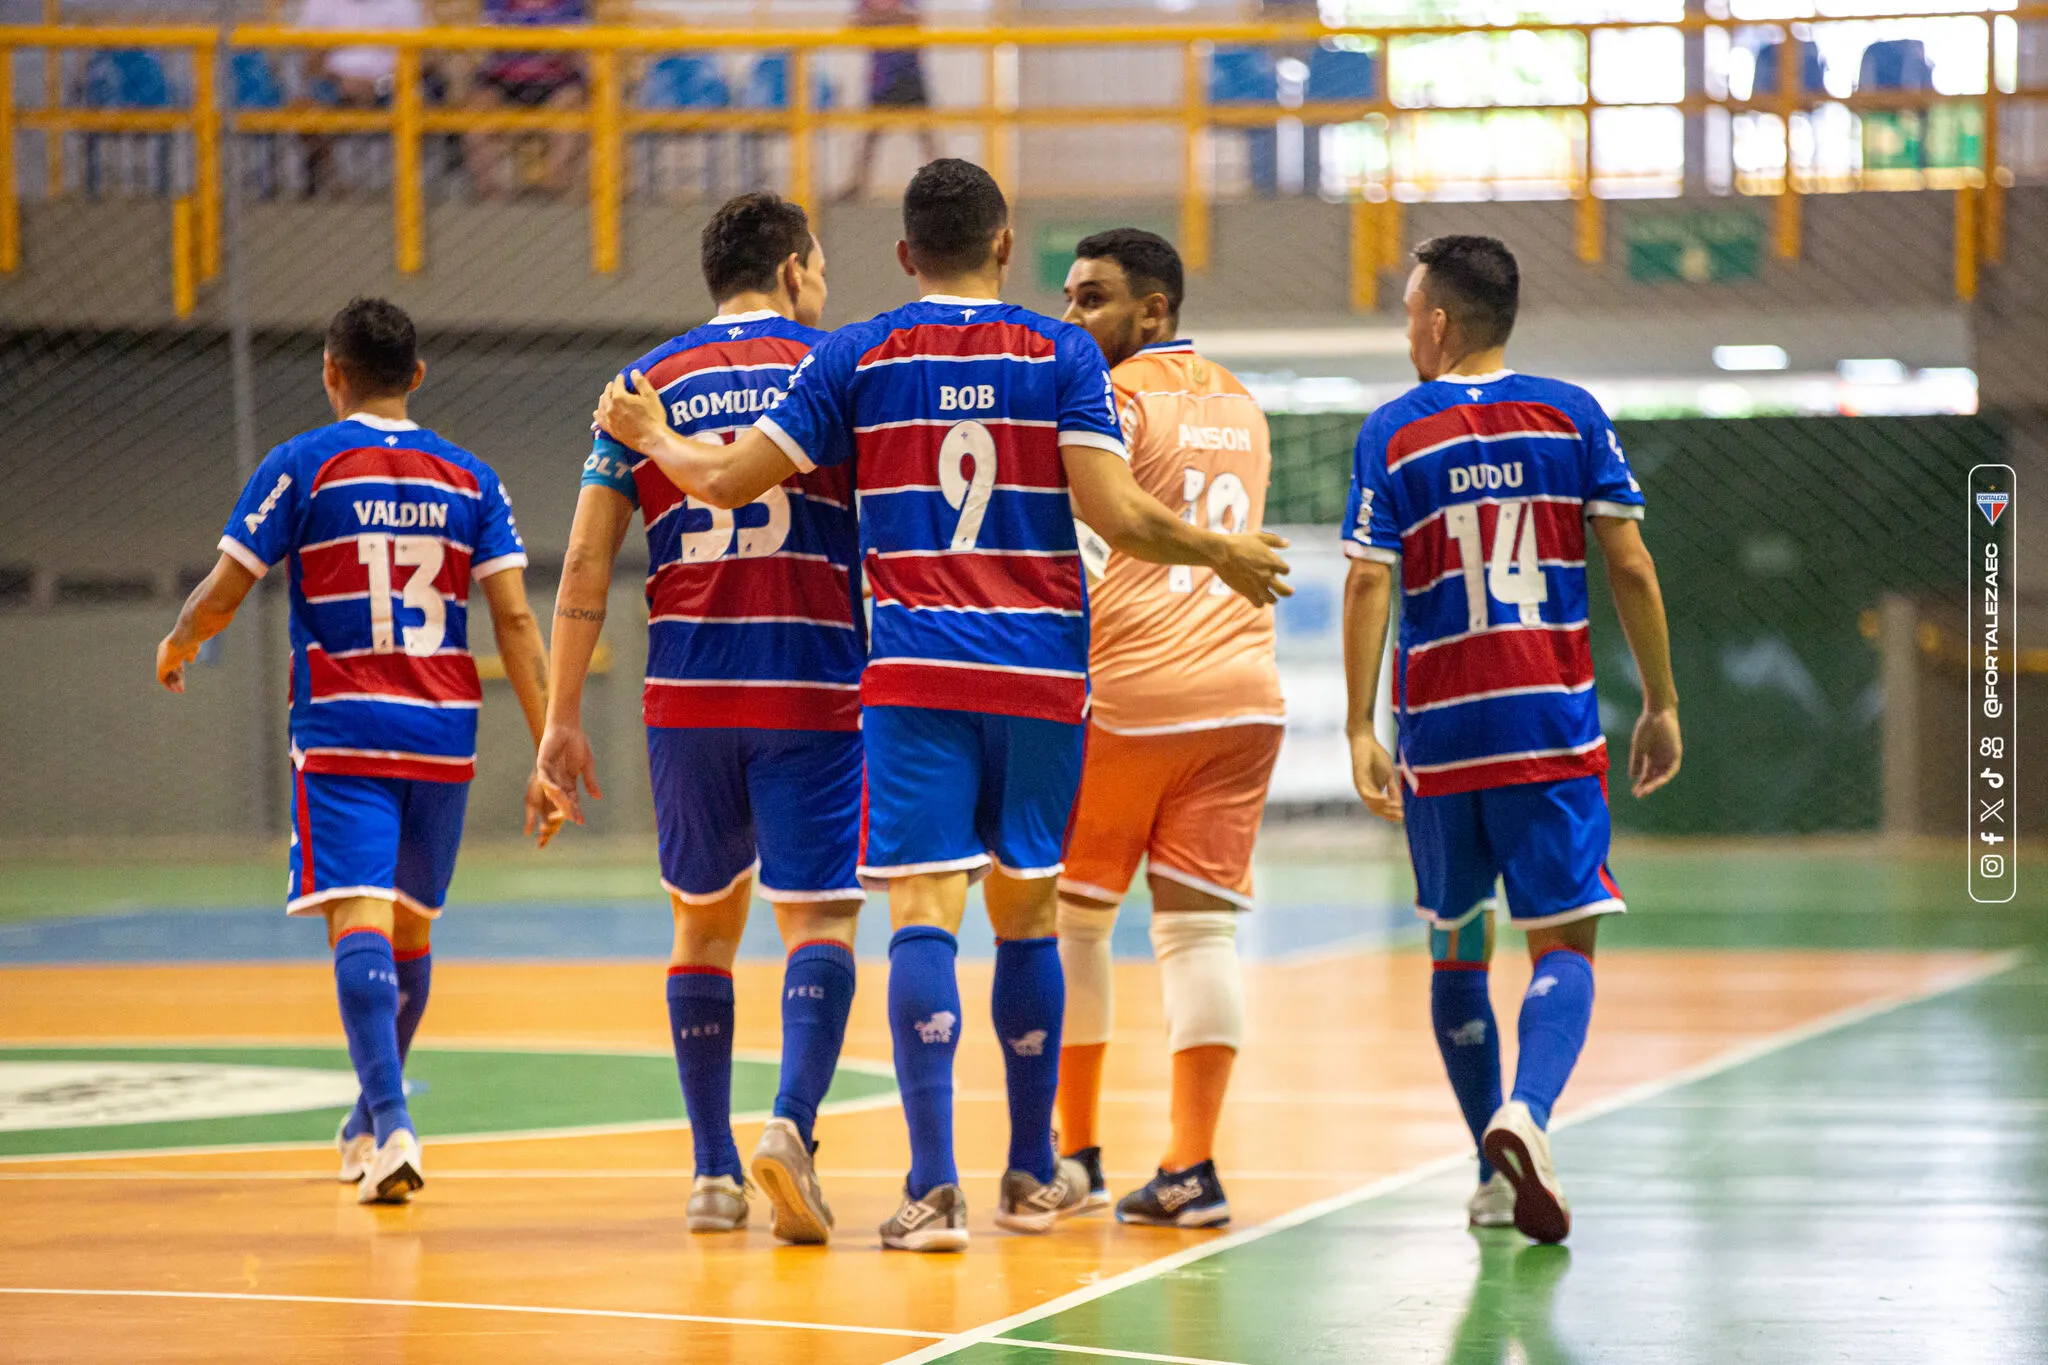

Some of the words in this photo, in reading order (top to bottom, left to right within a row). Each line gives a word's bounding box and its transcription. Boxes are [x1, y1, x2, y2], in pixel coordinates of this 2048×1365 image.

[669, 387, 780, 427] ROMULO
[939, 384, 995, 411] BOB
[938, 419, 997, 551] 9
[1448, 462, 1523, 494] DUDU
[353, 499, 448, 528] VALDIN
[1445, 500, 1548, 634] 14
[357, 532, 446, 658] 13
